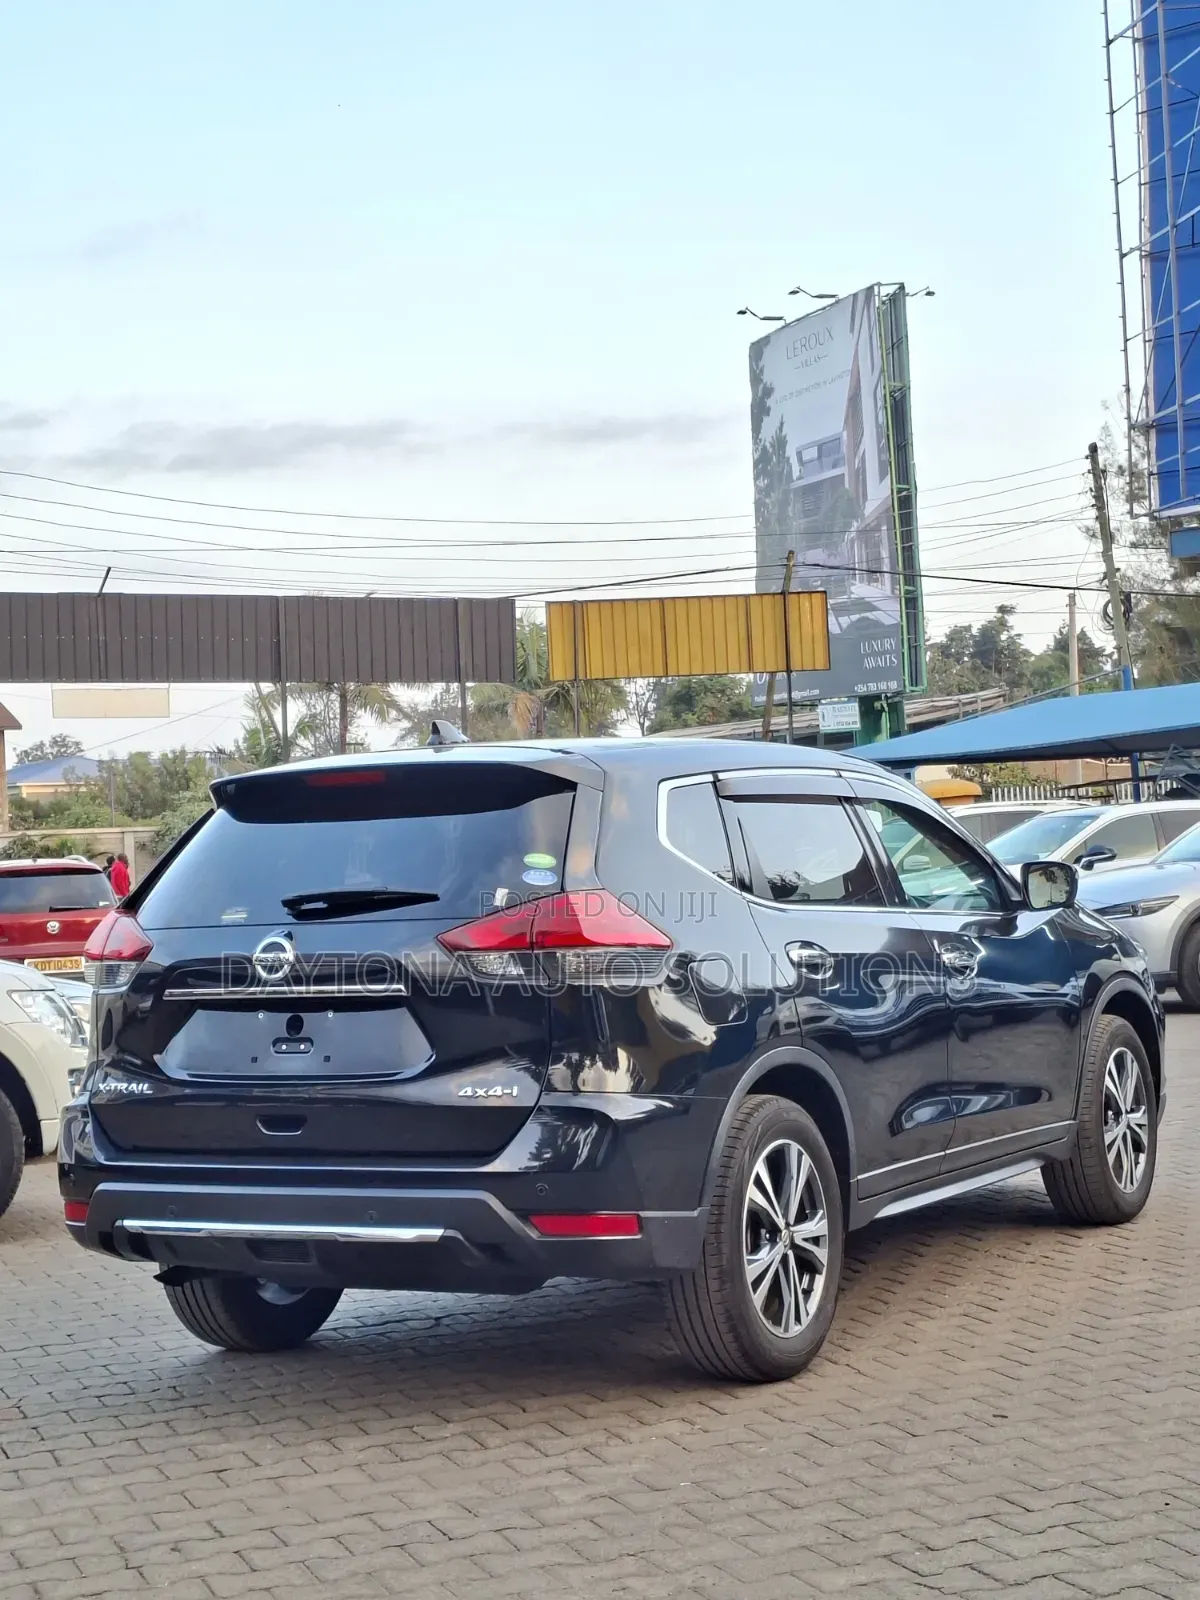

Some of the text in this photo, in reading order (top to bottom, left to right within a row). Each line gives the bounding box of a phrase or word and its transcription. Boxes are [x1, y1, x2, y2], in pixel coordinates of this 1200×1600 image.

[786, 327, 834, 359] LEROUX
[860, 637, 897, 654] LUXURY
[863, 653, 898, 670] AWAITS
[254, 956, 292, 965] NISSAN
[98, 1082, 154, 1094] X-TRAIL
